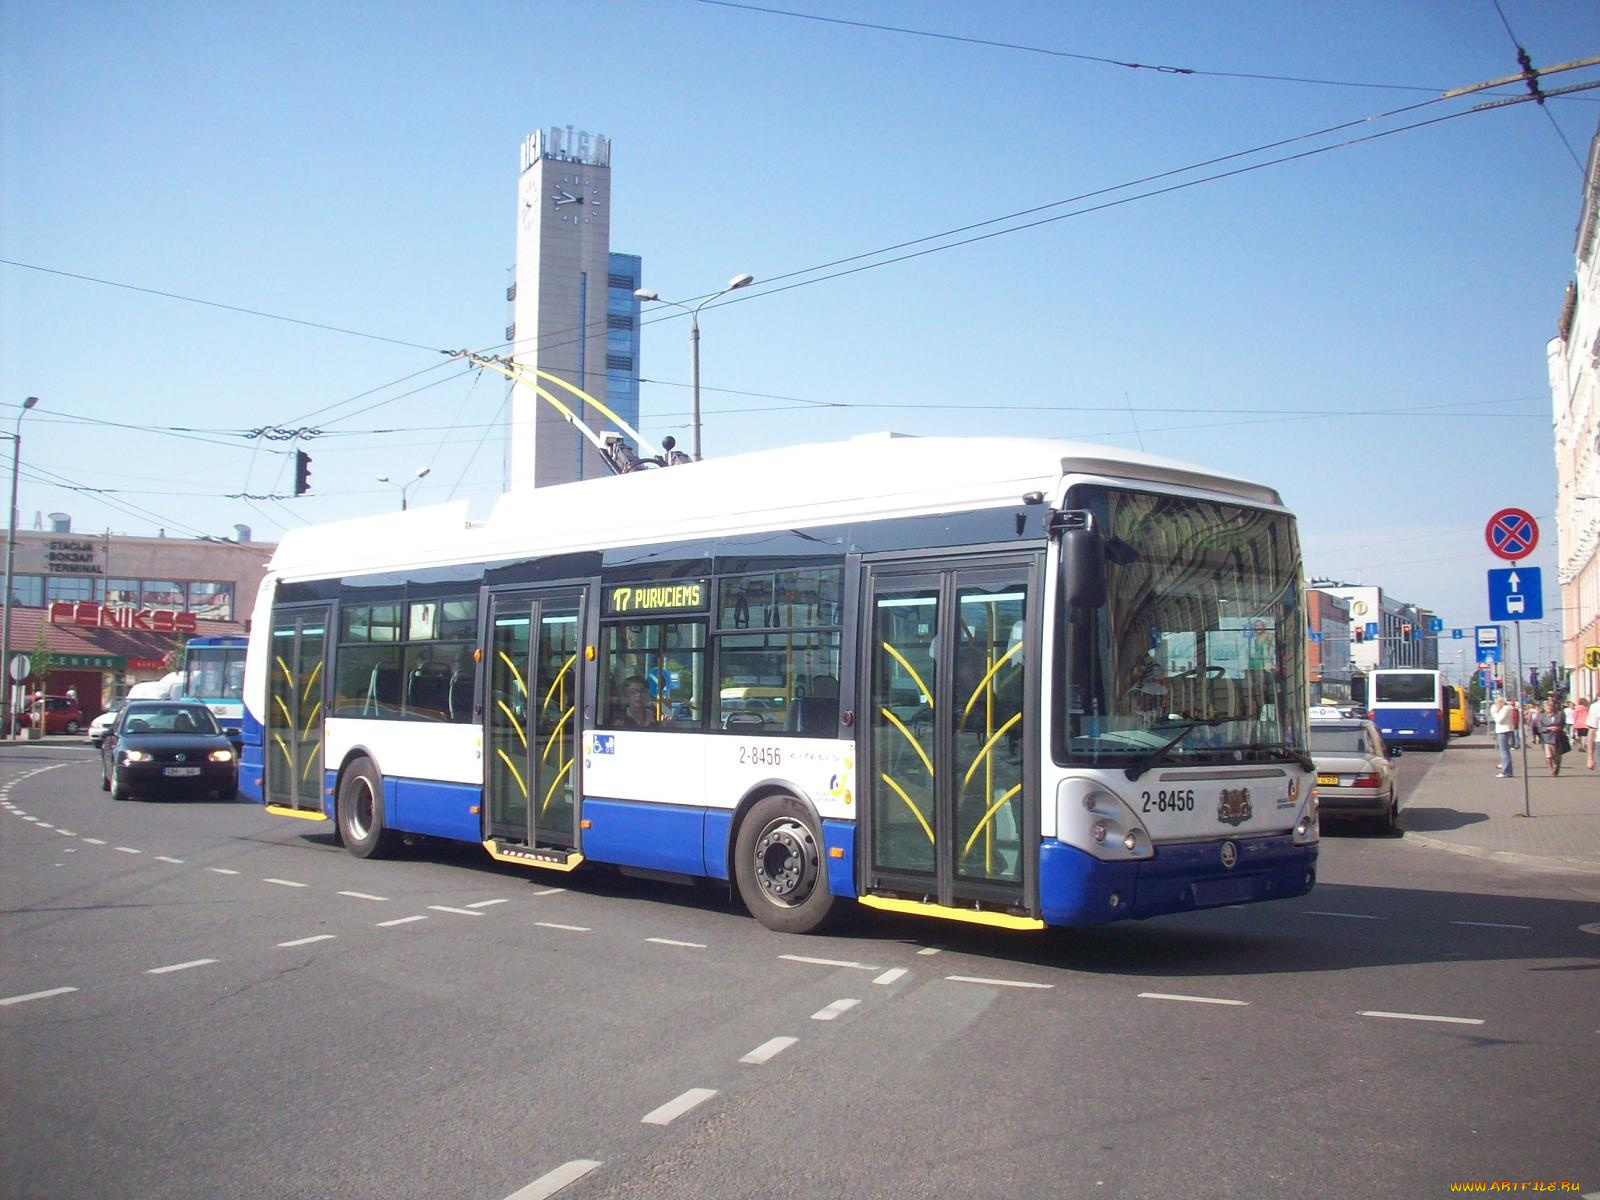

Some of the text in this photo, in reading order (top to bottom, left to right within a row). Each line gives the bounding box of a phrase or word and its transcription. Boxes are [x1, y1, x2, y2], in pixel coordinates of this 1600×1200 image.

[50, 541, 94, 551] STACIJA
[49, 552, 93, 562] ВОКЗАЛ
[48, 563, 104, 574] TERMINAL
[613, 585, 700, 611] 17 PURVCIEMS
[48, 656, 113, 668] CENTRS
[739, 746, 781, 766] 2-8456
[1141, 789, 1195, 813] 2-8456
